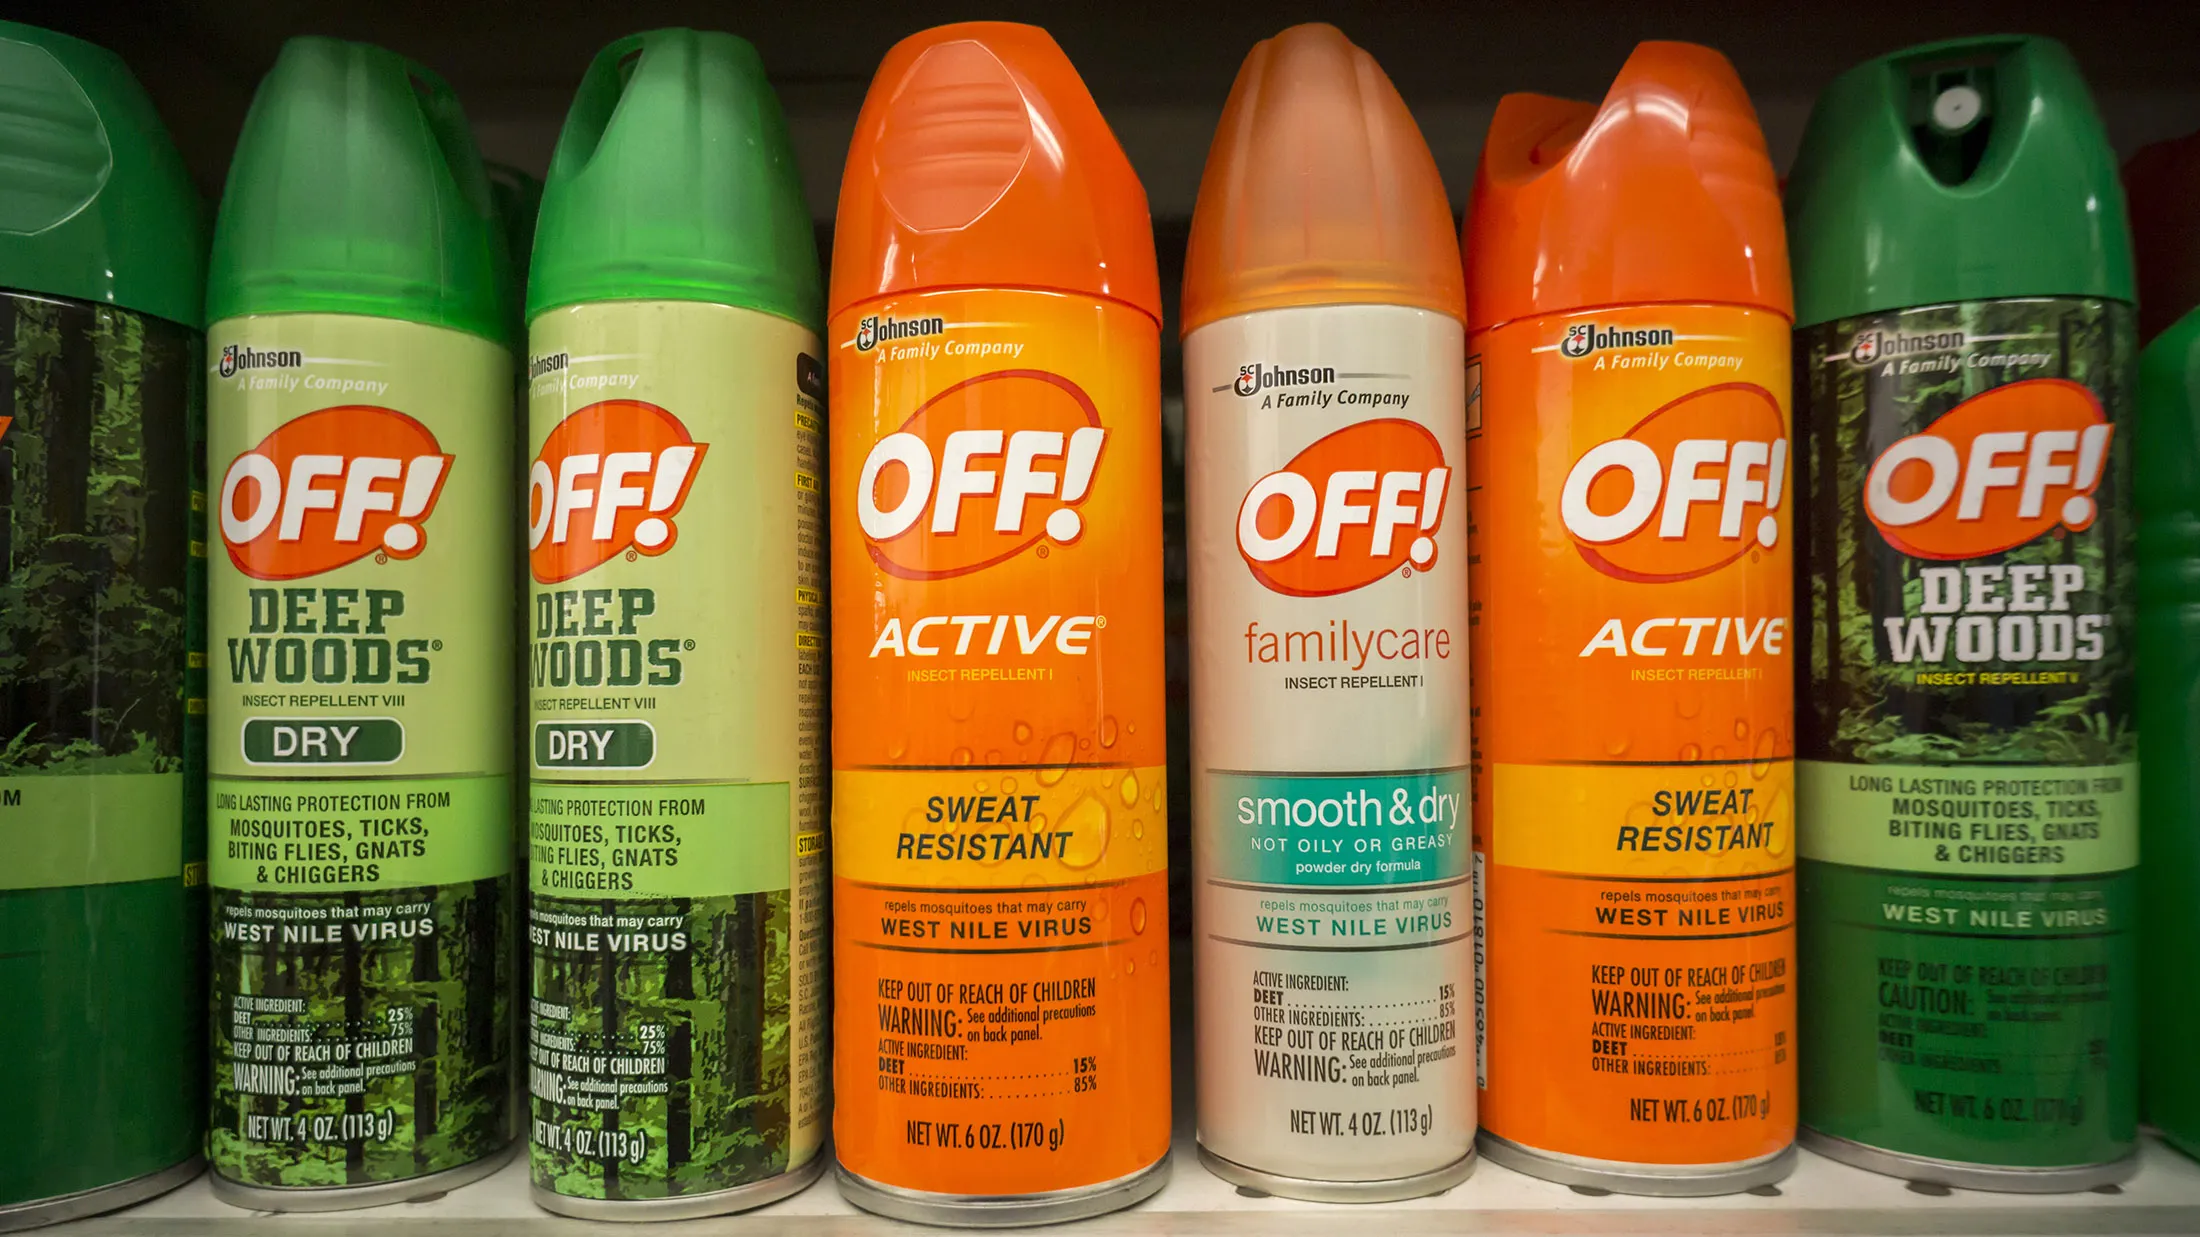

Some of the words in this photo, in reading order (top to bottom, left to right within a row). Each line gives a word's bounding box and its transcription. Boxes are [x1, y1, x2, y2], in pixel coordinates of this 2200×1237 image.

[856, 316, 944, 352] Johnson
[1561, 324, 1673, 358] Johnson
[220, 345, 301, 377] Johnson
[877, 348, 886, 363] A
[891, 343, 940, 360] Family
[945, 340, 1024, 358] Company
[1593, 355, 1605, 371] A
[1611, 352, 1670, 370] Family
[1673, 351, 1743, 371] Company
[237, 376, 245, 391] A
[251, 375, 299, 392] Family
[304, 375, 389, 395] Company
[570, 374, 639, 390] Company
[1234, 363, 1335, 397] Johnson
[1261, 395, 1272, 410] A
[1276, 391, 1333, 409] Family
[1337, 389, 1410, 409] Company
[858, 426, 1105, 542] OFF!
[1868, 423, 2112, 526] OFF!
[221, 453, 444, 551] OFF!
[530, 446, 696, 550] OFF!
[1561, 437, 1787, 548] OFF!
[1238, 467, 1451, 564] OFF!
[1920, 564, 2085, 614] DEEP
[249, 588, 405, 634] DEEP
[536, 588, 655, 638] DEEP
[1244, 620, 1450, 671] familycare
[908, 669, 957, 682] INSECT
[961, 668, 1045, 681] REPELLENT
[1285, 676, 1337, 690] INSECT
[1340, 676, 1418, 689] REPELLENT
[1631, 669, 1684, 681] INSECT
[1688, 668, 1757, 681] REPELLENT
[1916, 672, 1976, 686] INSECT
[1979, 672, 2066, 685] REPELLENT
[242, 695, 285, 707] INSECT
[290, 695, 379, 707] REPELLENT
[382, 695, 405, 707] VIII
[560, 698, 630, 710] REPELLENT
[634, 697, 656, 710] VIII
[273, 726, 360, 757] DRY
[550, 730, 615, 762] DRY
[217, 793, 236, 810] LONG
[240, 795, 291, 812] LASTING
[298, 794, 400, 812] PROTECTION
[407, 791, 450, 809] FROM
[567, 800, 653, 817] PROTECTION
[659, 798, 706, 816] FROM
[926, 795, 1040, 823] SWEAT
[1237, 789, 1382, 827] smooth
[1389, 787, 1416, 826] &
[1418, 786, 1460, 830] dry
[1651, 789, 1754, 816] SWEAT
[1892, 798, 2040, 821] MOSQUITOES,
[230, 819, 352, 841] MOSQUITOES,
[360, 816, 429, 837] TICKS,
[615, 824, 682, 846] TICKS,
[1616, 822, 1774, 852] RESISTANT
[1888, 820, 1962, 840] BITING
[1970, 823, 2036, 844] FLIES,
[229, 841, 277, 861] BITING
[285, 843, 348, 864] FLIES,
[356, 839, 426, 860] GNATS
[896, 831, 1074, 861] RESISTANT
[1251, 837, 1288, 852] NOT
[1297, 839, 1344, 853] OILY
[1354, 839, 1382, 852] OR
[1392, 833, 1453, 852] GREASY
[1958, 846, 2065, 864] CHIGGERS
[558, 848, 605, 870] FLIES,
[612, 848, 678, 867] GNATS
[1296, 861, 1347, 875] powder
[1350, 861, 1372, 876] dry
[1376, 858, 1421, 872] formula
[256, 866, 268, 883] &
[275, 864, 380, 884] CHIGGERS
[542, 869, 548, 888] &
[552, 870, 633, 890] CHIGGERS
[226, 905, 253, 919] repels
[255, 906, 327, 921] mosquitoes
[331, 906, 359, 918] that
[363, 905, 392, 919] may
[396, 902, 431, 916] carry
[884, 900, 917, 913] repels
[920, 901, 993, 916] mosquitoes
[997, 901, 1022, 914] that
[1026, 901, 1053, 915] may
[1056, 899, 1087, 912] carry
[1260, 900, 1295, 912] repels
[1299, 900, 1373, 914] mosquitoes
[1376, 900, 1399, 911] that
[1403, 897, 1424, 911] may
[1427, 895, 1449, 908] carry
[1596, 907, 1668, 926] WEST
[1678, 908, 1730, 926] NILE
[1738, 901, 1784, 923] VIRUS
[1882, 902, 1959, 924] WEST
[1969, 908, 2032, 928] NILE
[2040, 908, 2108, 928] VIRUS
[224, 921, 274, 943] WEST
[284, 924, 343, 943] NILE
[352, 918, 435, 942] VIRUS
[881, 917, 940, 939] WEST
[950, 920, 1008, 940] NILE
[1018, 916, 1092, 938] VIRUS
[1256, 915, 1321, 935] WEST
[1332, 918, 1387, 936] NILE
[1396, 911, 1452, 934] VIRUS
[555, 931, 599, 951] NILE
[607, 932, 687, 952] VIRUS
[878, 978, 903, 1001] KEEP
[907, 981, 932, 1003] OUT
[936, 983, 954, 1004] OF
[959, 983, 1003, 1005] REACH
[1009, 982, 1028, 1004] OF
[1033, 977, 1096, 1002] CHILDREN
[878, 1003, 963, 1039] WARNING:
[967, 1008, 985, 1024] See
[988, 1005, 1040, 1023] additional
[1043, 1003, 1096, 1025] precautions
[967, 1031, 980, 1042] on
[983, 1026, 1007, 1043] back
[1011, 1024, 1043, 1045] panel.
[878, 1038, 904, 1056] ACTIVE
[907, 1042, 968, 1061] INGREDIENT:
[878, 1056, 905, 1075] DEET
[1073, 1056, 1097, 1074] 15%
[878, 1075, 906, 1094] OTHER
[909, 1080, 984, 1099] INGREDIENTS:
[1074, 1075, 1097, 1093] 85%
[248, 1115, 269, 1141] NET
[272, 1116, 294, 1141] WT.
[298, 1116, 306, 1141] 4
[314, 1116, 338, 1141] OZ.
[907, 1120, 932, 1147] NET
[936, 1123, 962, 1148] WT.
[965, 1124, 975, 1149] 6
[979, 1124, 1007, 1149] OZ.
